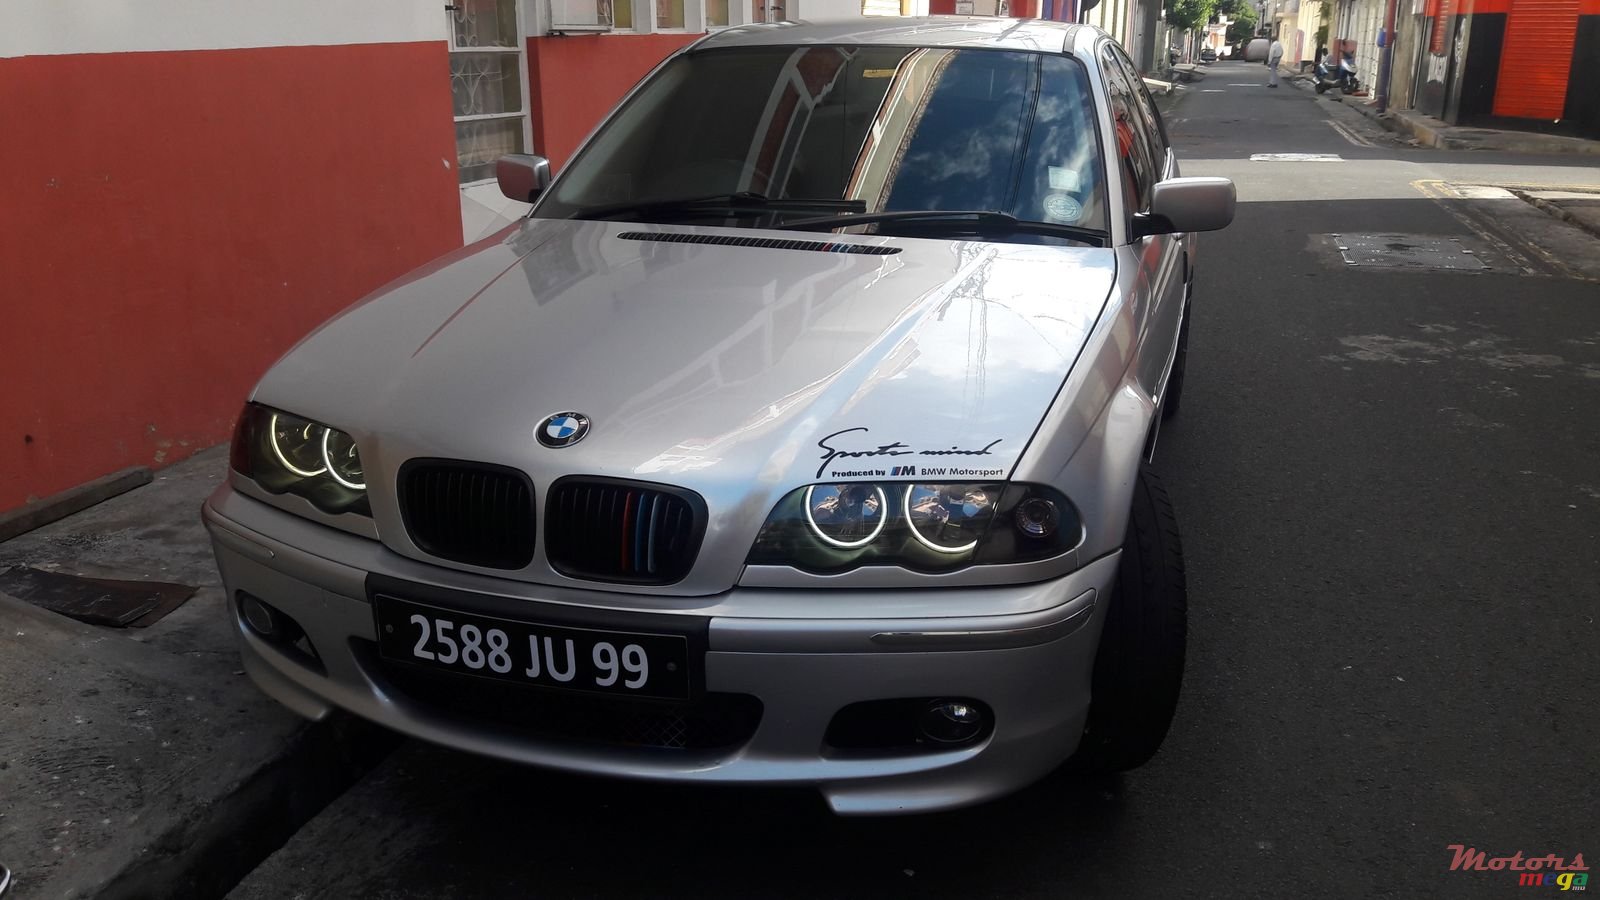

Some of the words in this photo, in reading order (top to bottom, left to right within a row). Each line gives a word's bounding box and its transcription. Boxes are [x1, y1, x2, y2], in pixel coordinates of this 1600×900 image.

[831, 470, 874, 478] Produced
[875, 468, 886, 477] by
[921, 467, 947, 476] BMW
[949, 467, 1004, 478] Motorsport
[410, 614, 513, 673] 2588
[525, 634, 577, 682] JU
[592, 641, 649, 689] 99
